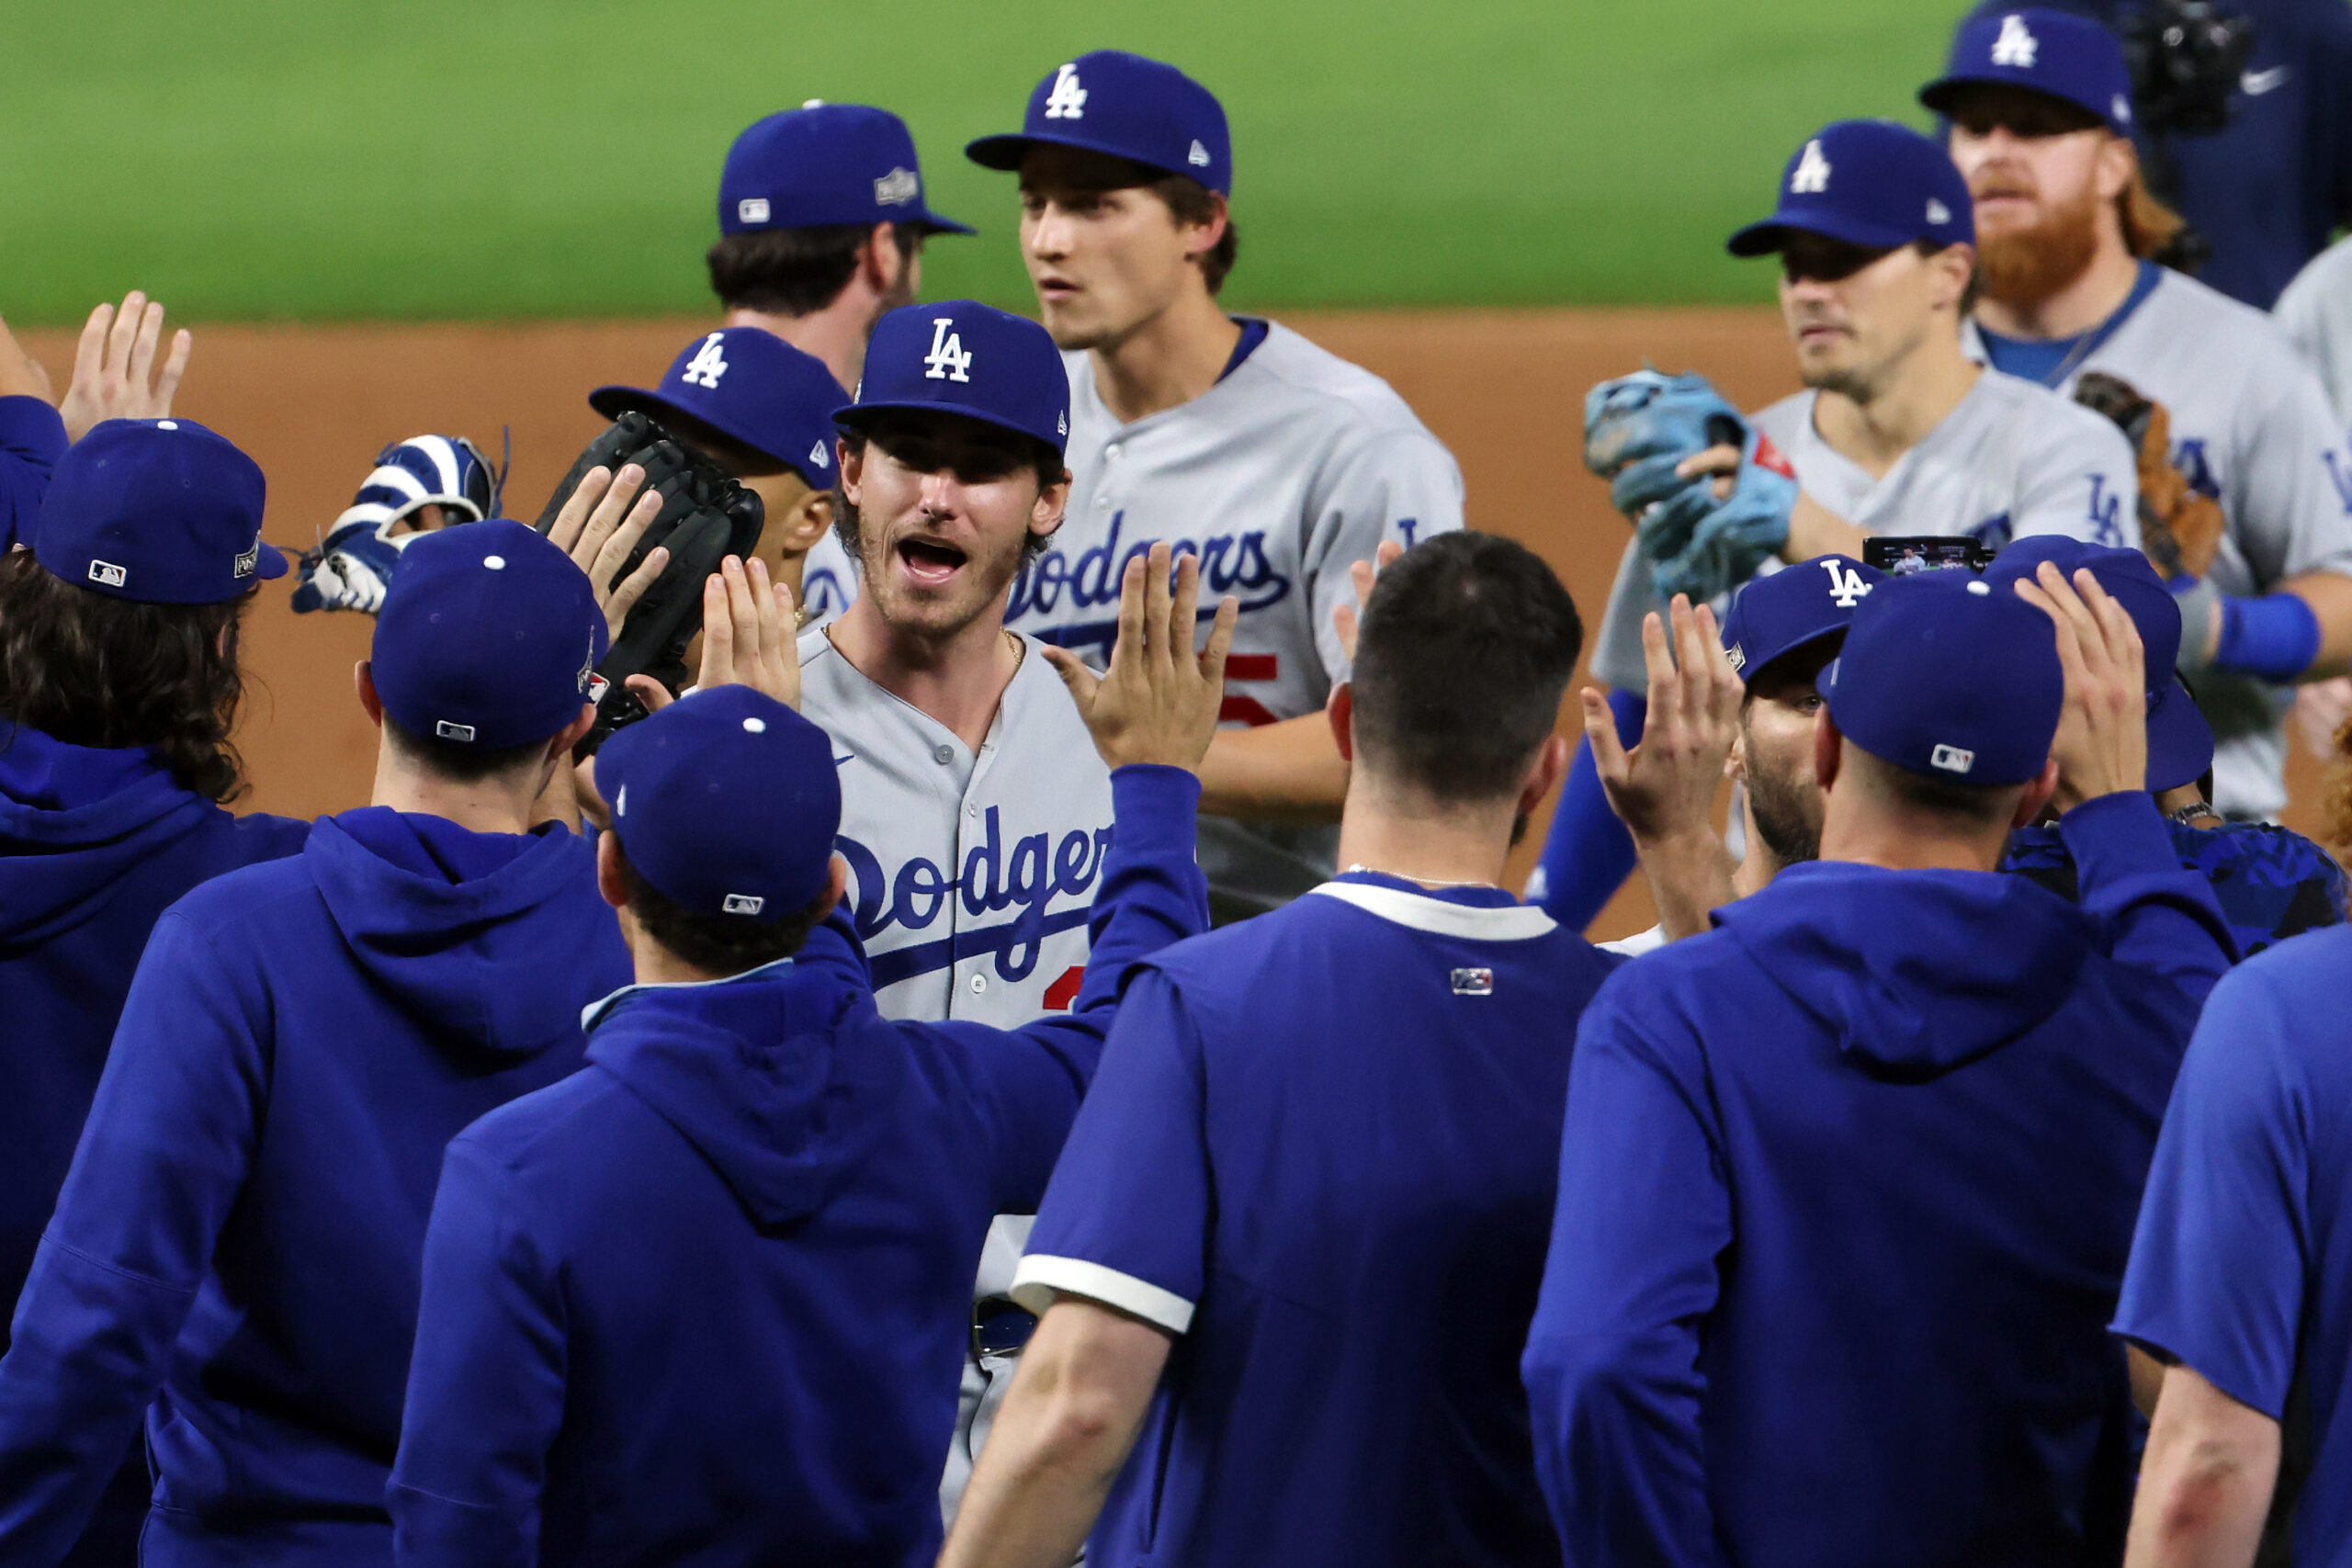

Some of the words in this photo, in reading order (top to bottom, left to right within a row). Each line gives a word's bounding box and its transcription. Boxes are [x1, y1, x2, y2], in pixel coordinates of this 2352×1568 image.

[1045, 63, 1088, 119] LA
[682, 332, 728, 389] LA
[924, 318, 972, 382] LA
[1820, 558, 1874, 607] LA
[833, 805, 1114, 982] Dodger
